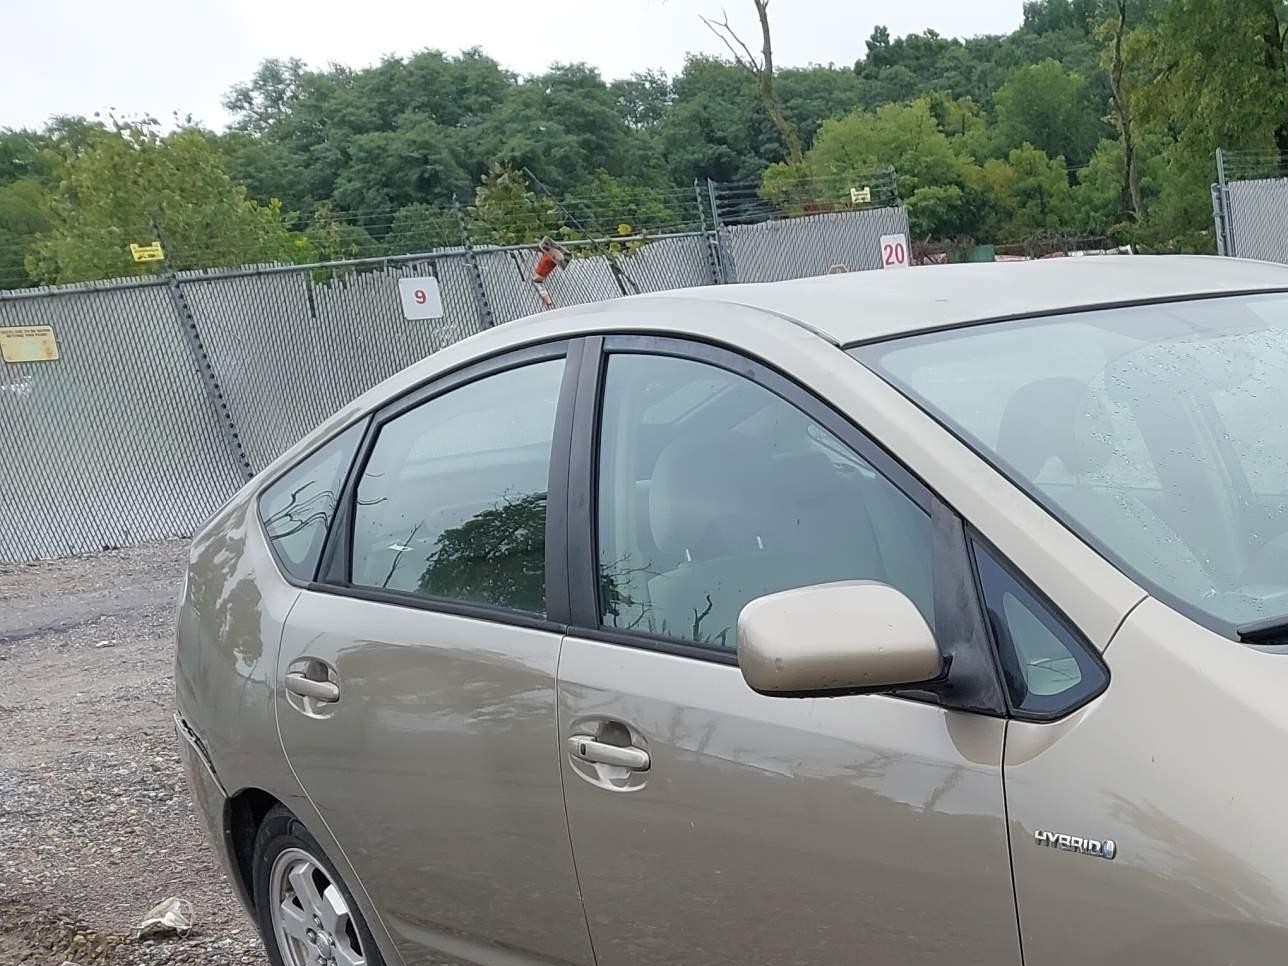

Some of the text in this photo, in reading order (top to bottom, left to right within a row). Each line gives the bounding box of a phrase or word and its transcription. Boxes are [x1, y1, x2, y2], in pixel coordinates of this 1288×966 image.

[884, 243, 904, 265] 20
[415, 290, 426, 304] 9
[1034, 830, 1104, 856] HYBRID
